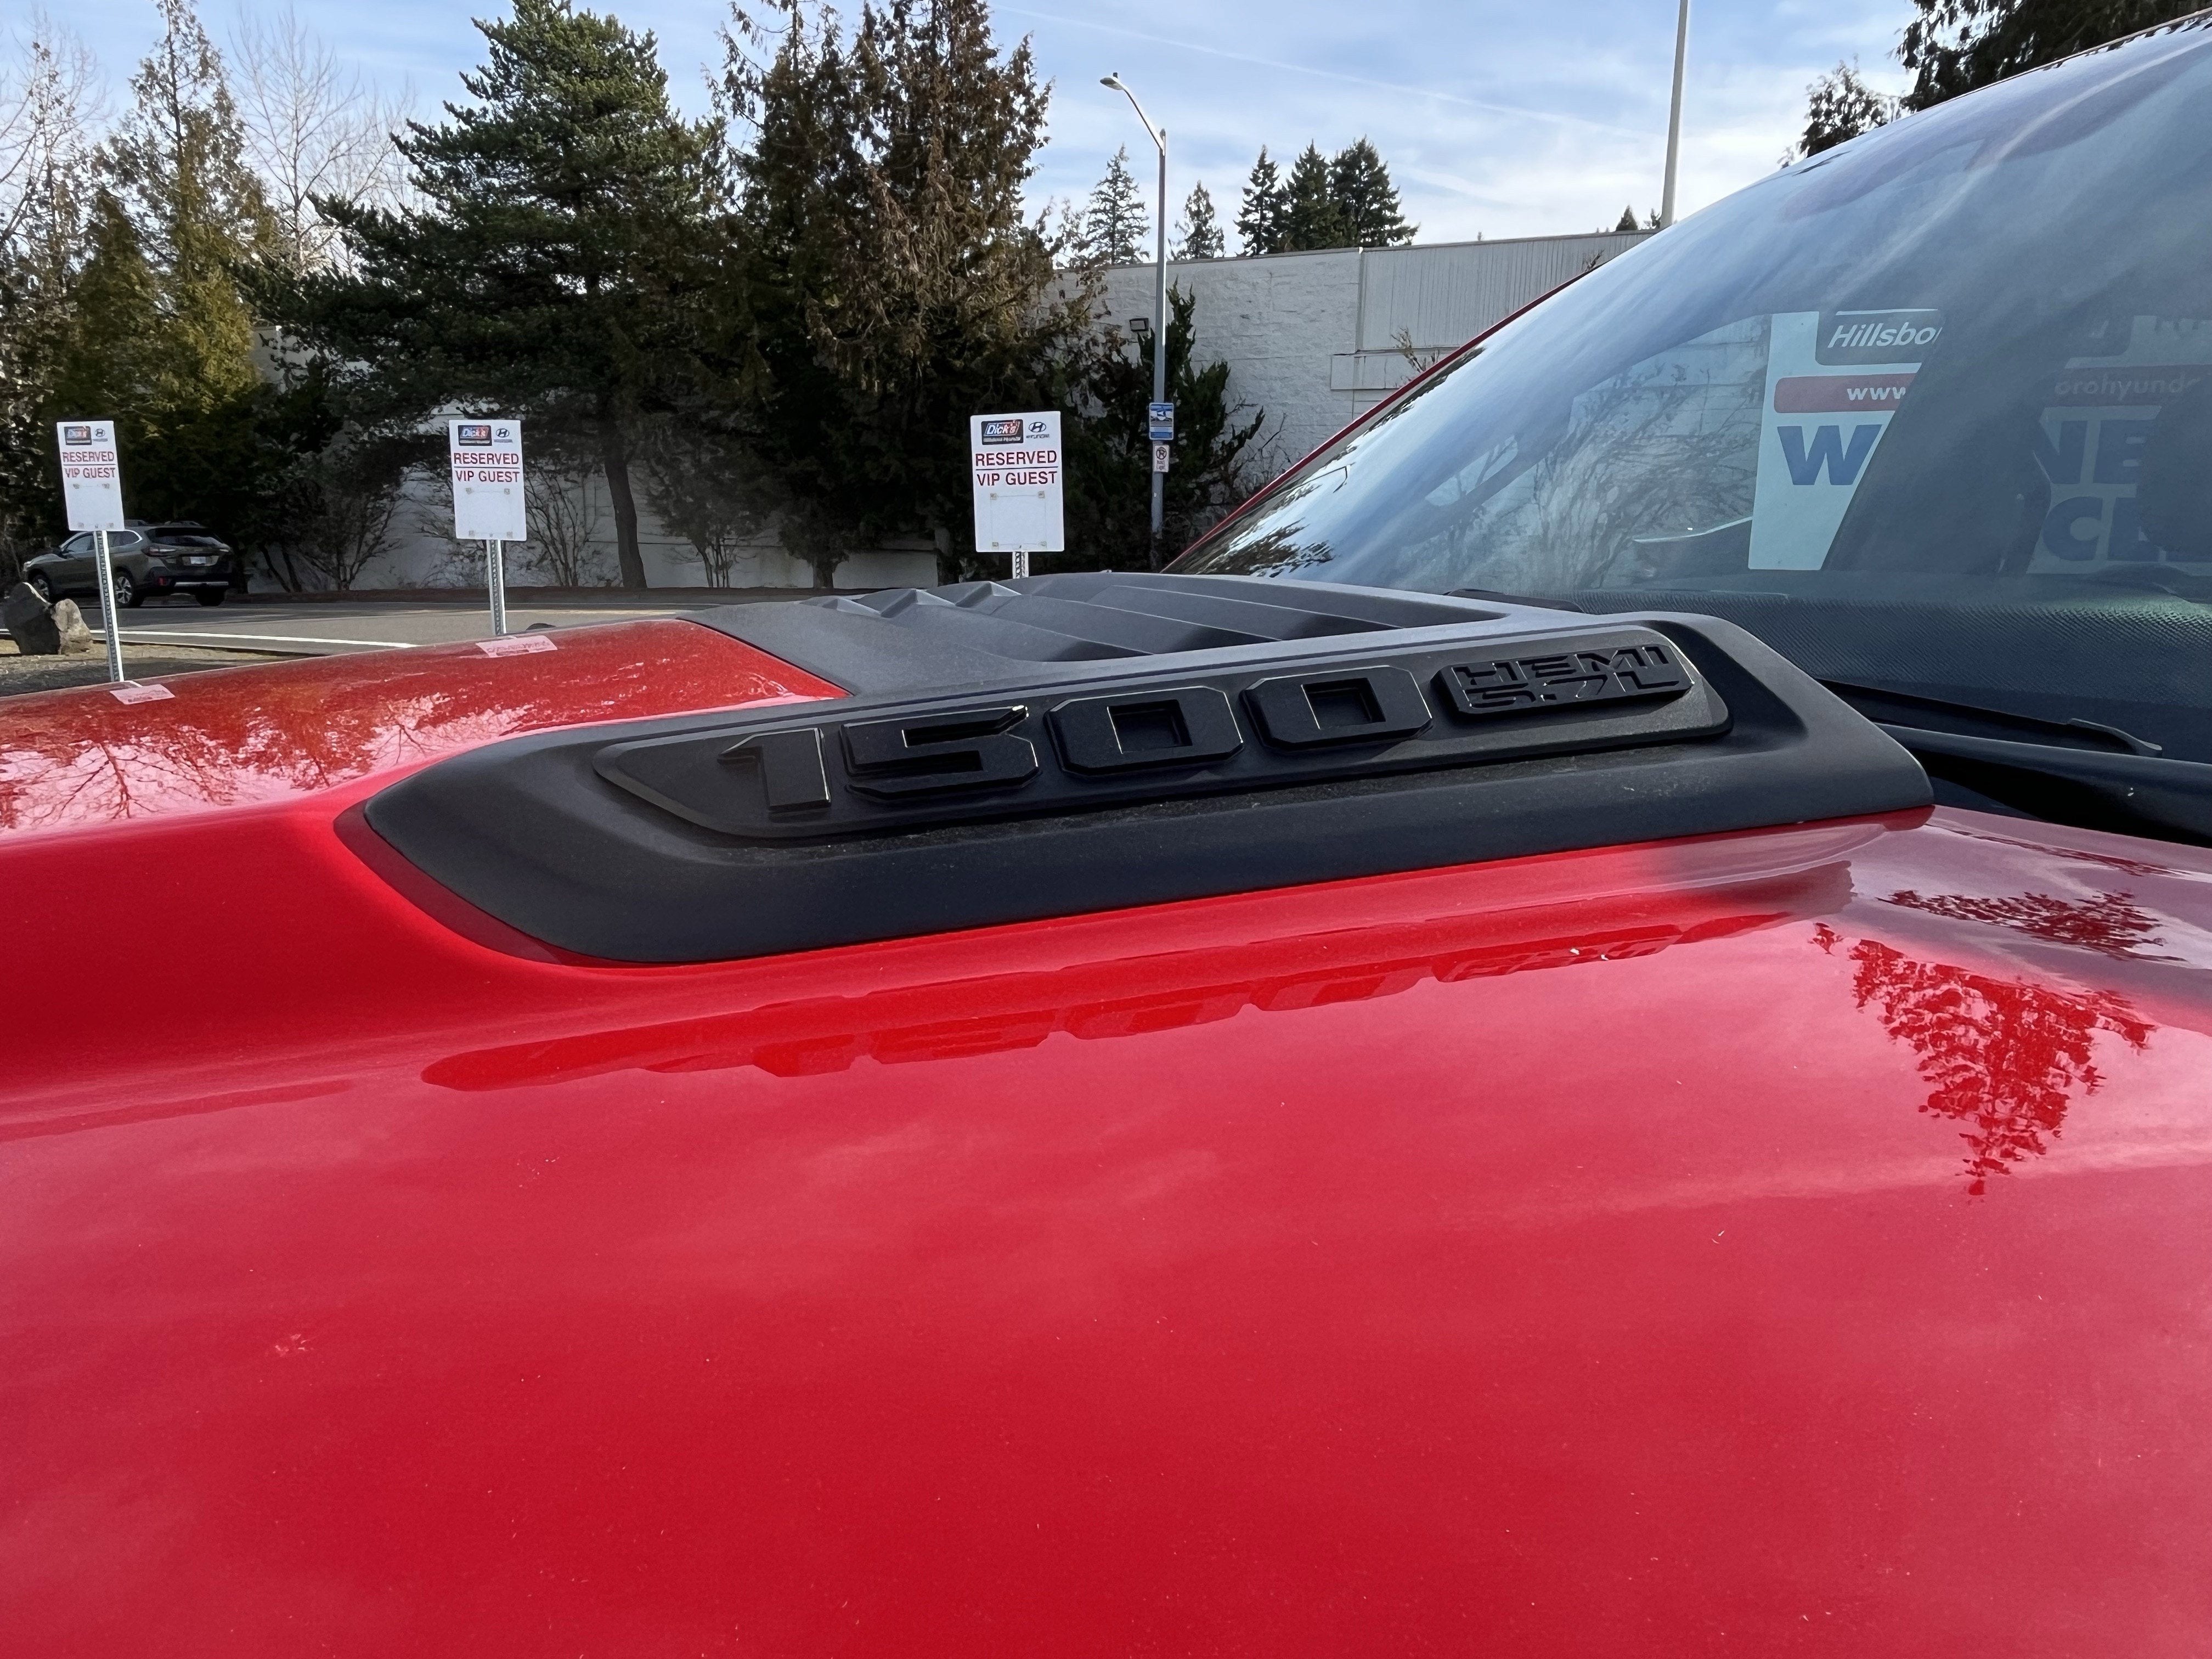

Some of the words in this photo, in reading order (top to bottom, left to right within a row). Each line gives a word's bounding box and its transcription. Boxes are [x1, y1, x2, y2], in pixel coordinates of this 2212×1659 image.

[62, 451, 114, 462] RESERVED
[454, 453, 519, 465] RESERVED
[975, 450, 1057, 466] RESERVED
[64, 467, 80, 478] VIP
[83, 467, 115, 478] GUEST
[455, 470, 474, 482] VIP
[478, 471, 520, 483] GUEST
[977, 472, 1000, 486] VIP
[1005, 471, 1057, 486] GUEST
[1451, 646, 1669, 685] HEMI
[716, 664, 1433, 814] 1500
